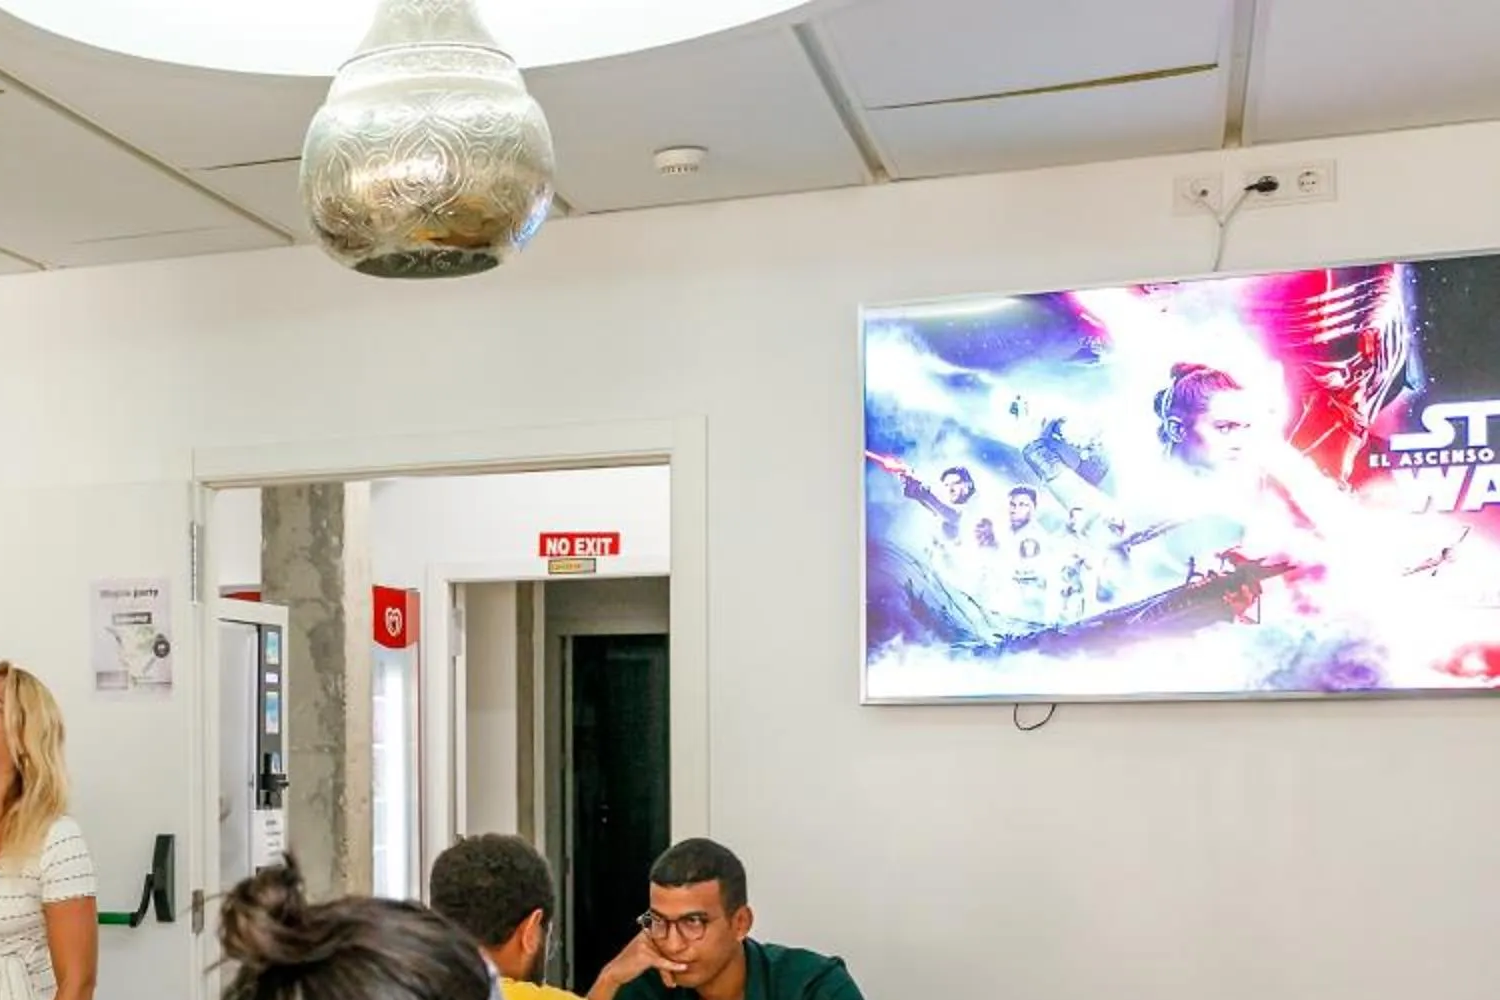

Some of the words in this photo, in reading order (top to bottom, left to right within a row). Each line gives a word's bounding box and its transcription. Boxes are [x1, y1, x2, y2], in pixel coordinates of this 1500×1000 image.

[1368, 454, 1391, 467] EL
[1399, 448, 1495, 465] ASCENSO
[545, 537, 571, 555] NO
[574, 537, 613, 556] EXIT
